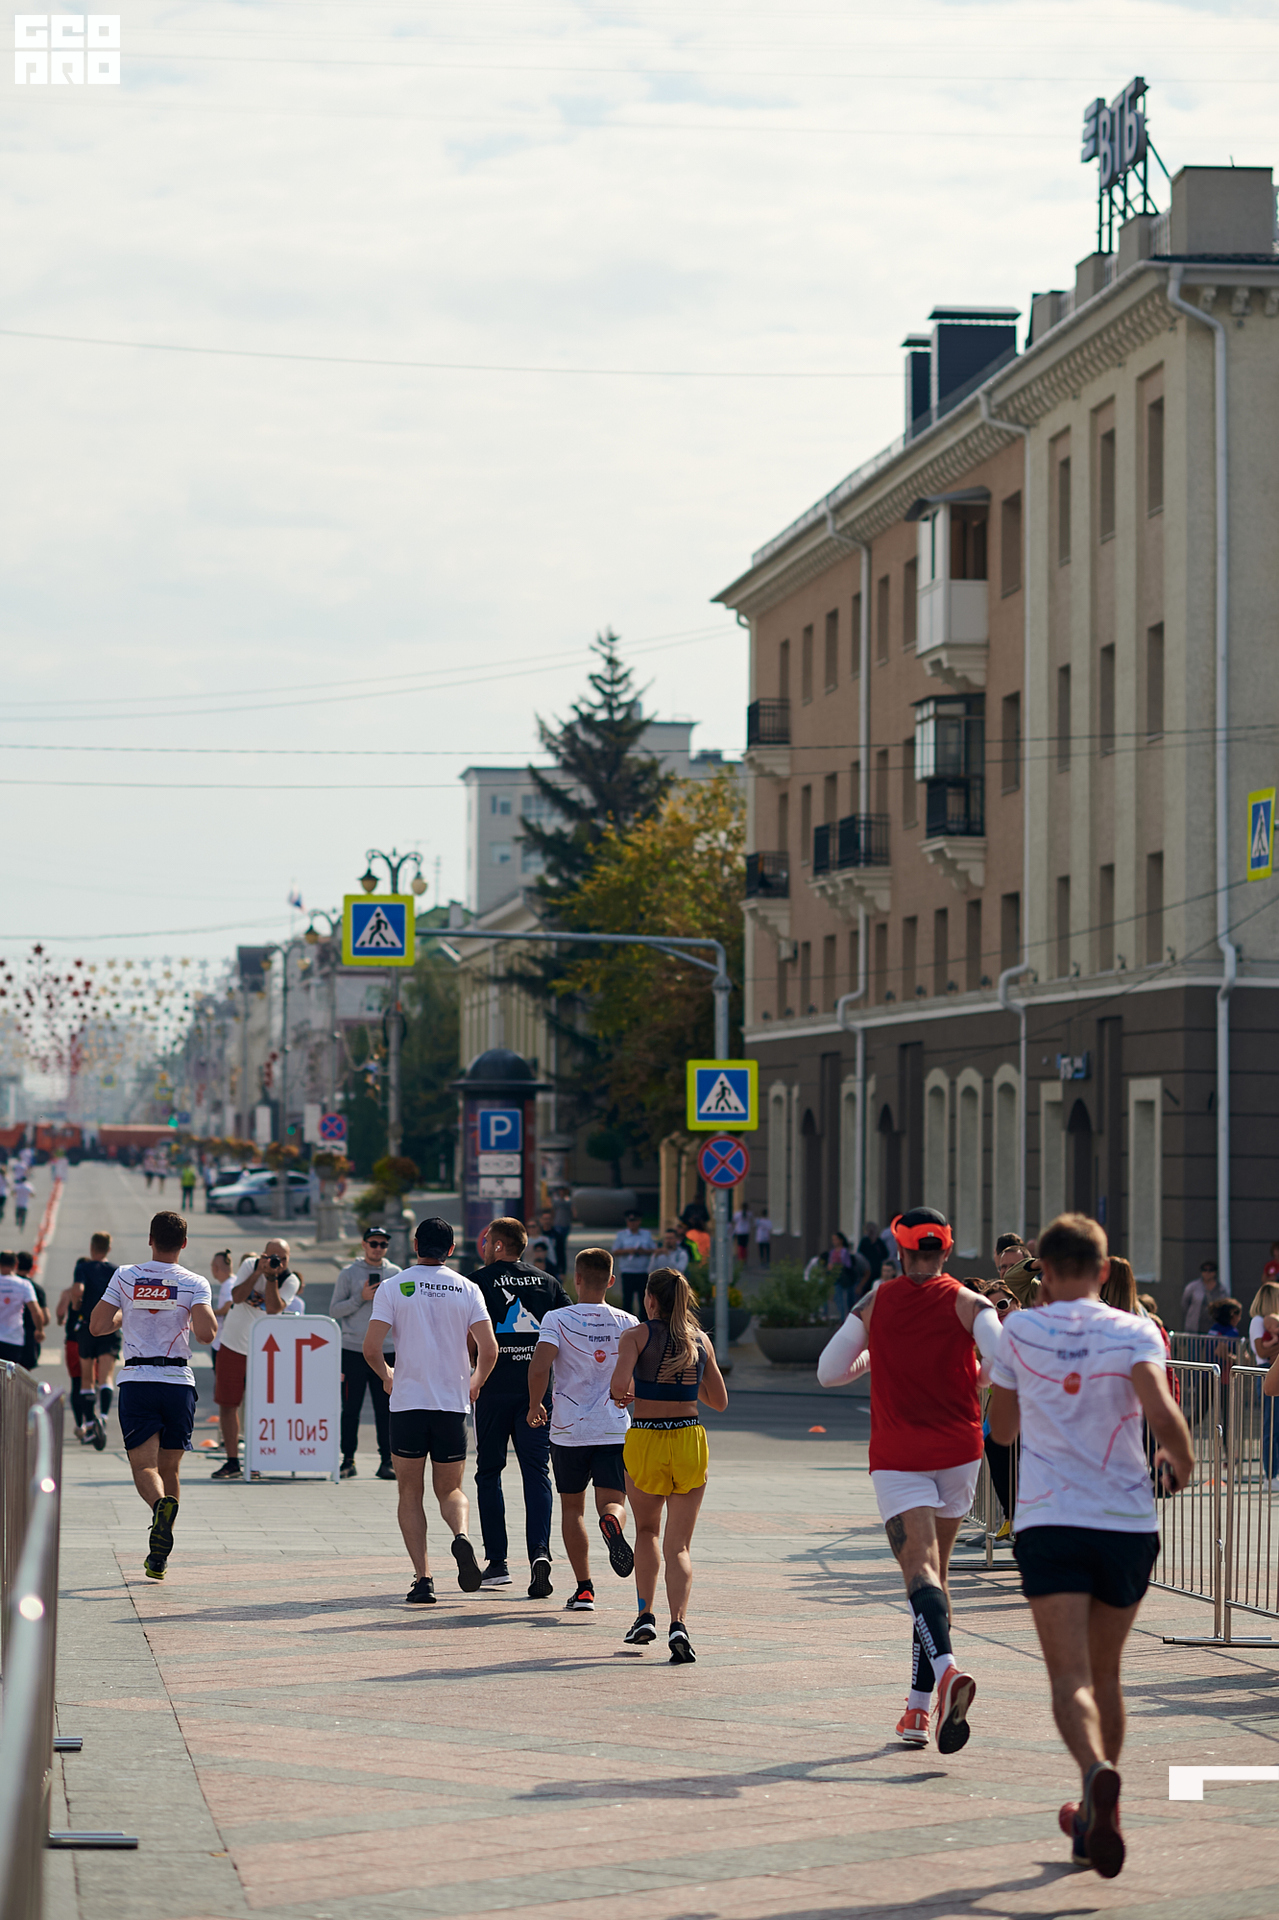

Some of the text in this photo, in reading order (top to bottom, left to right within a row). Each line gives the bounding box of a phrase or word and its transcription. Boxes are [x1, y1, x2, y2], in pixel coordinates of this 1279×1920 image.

[493, 1275, 545, 1288] АЙСБЕРГ
[136, 1287, 168, 1298] 2244
[419, 1281, 463, 1294] FREEDOM
[420, 1289, 446, 1298] finance
[498, 1345, 537, 1354] ГОТВОРИТЕ
[511, 1353, 532, 1361] ФОНД
[259, 1418, 275, 1441] 21
